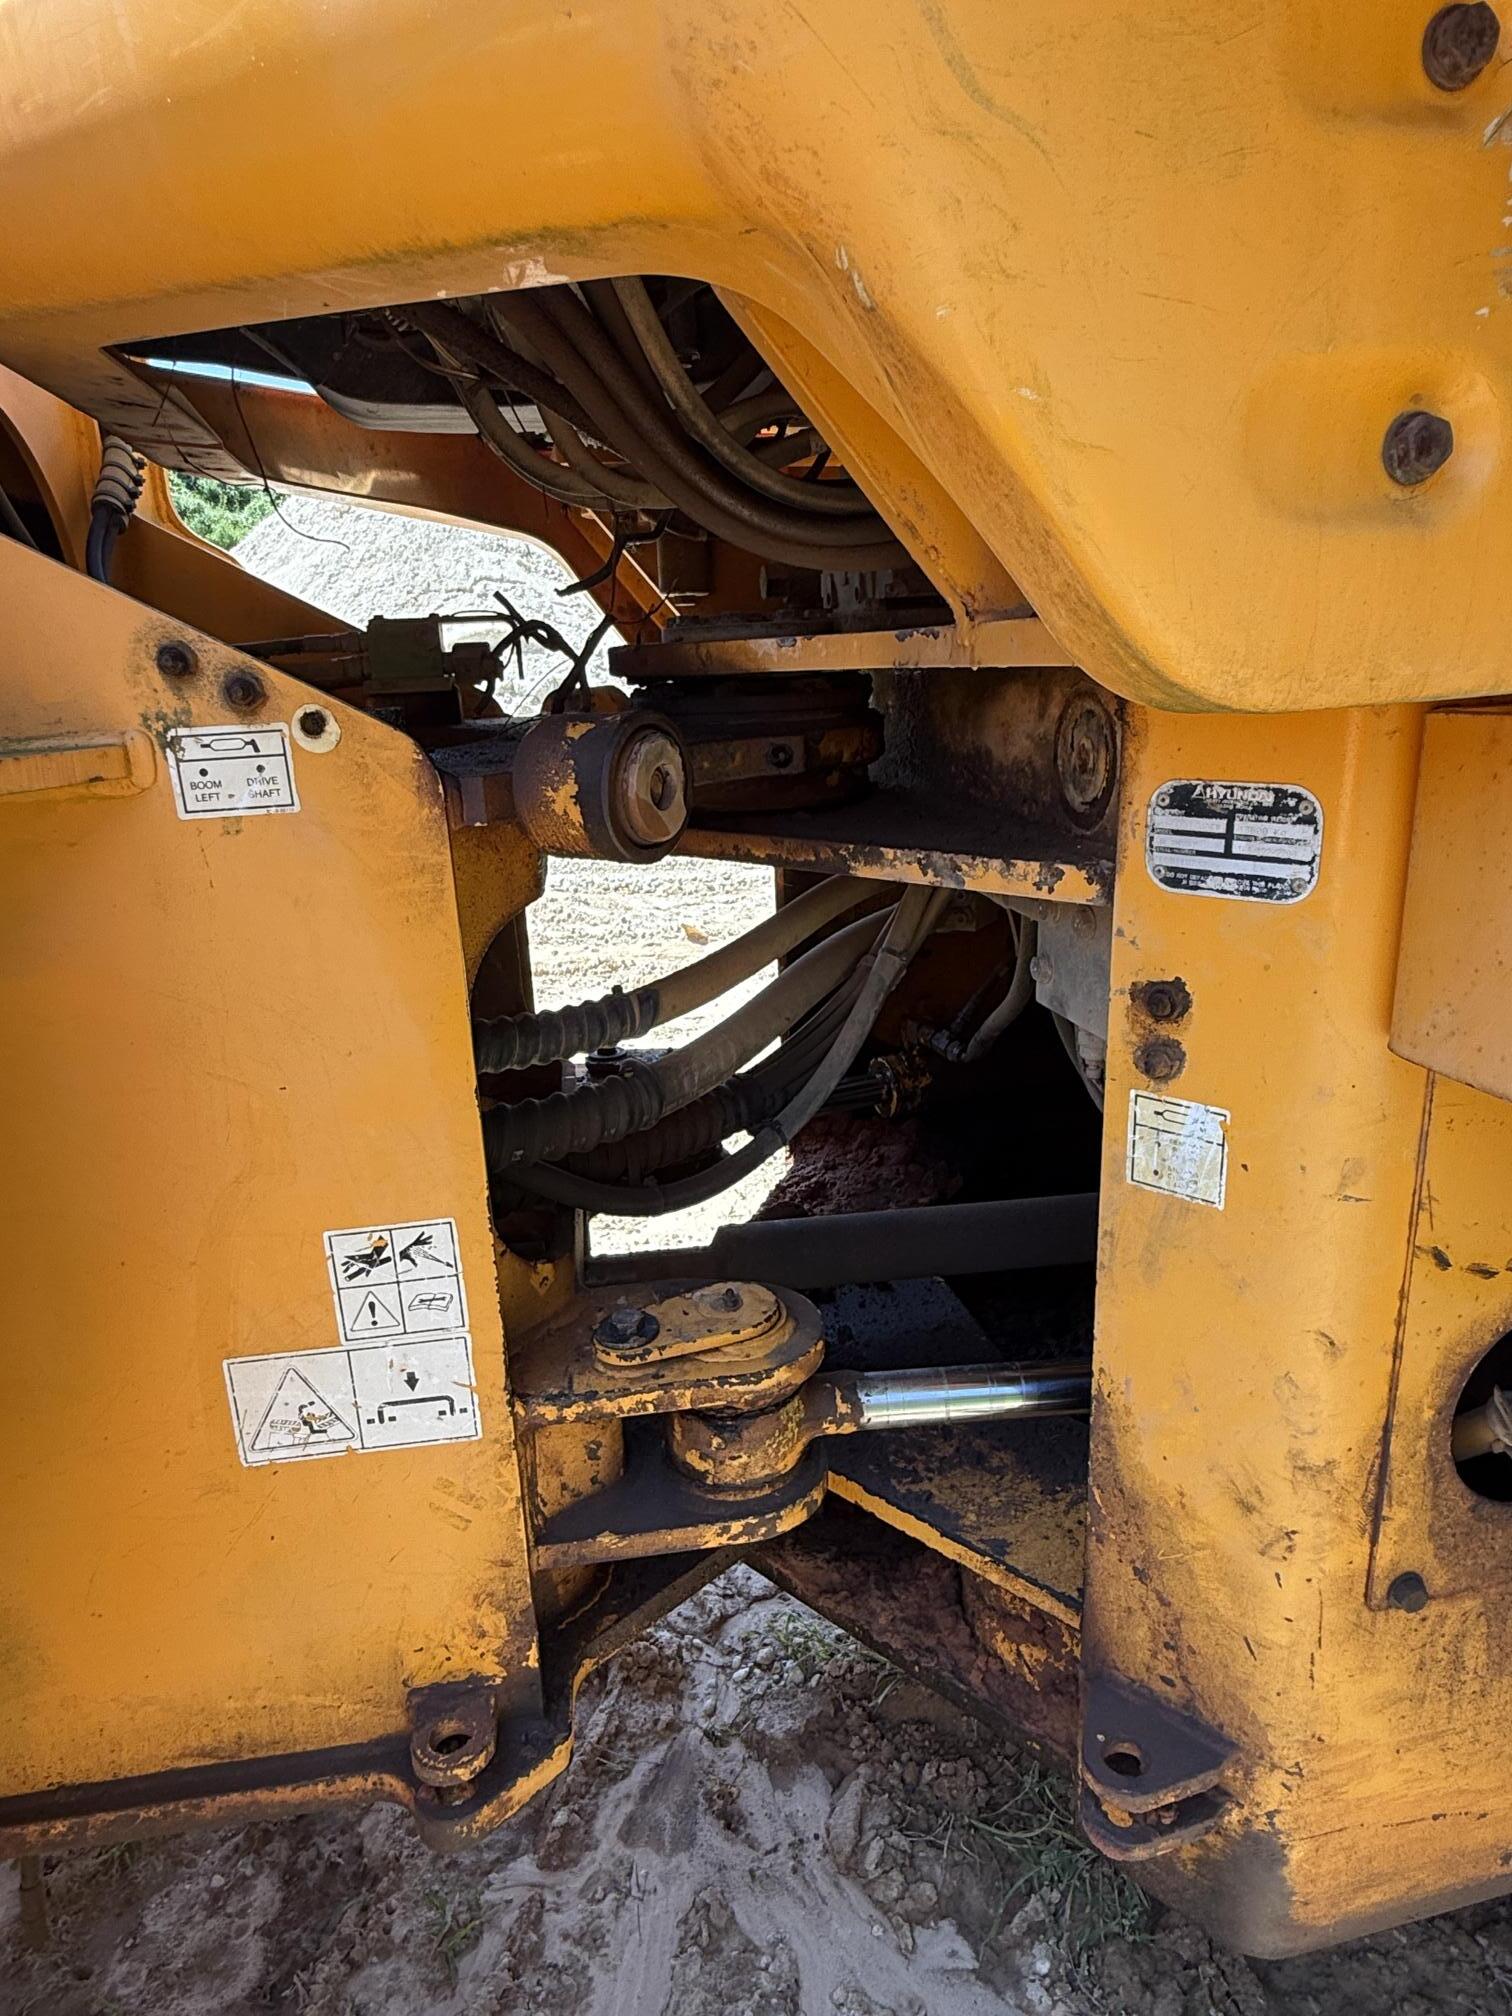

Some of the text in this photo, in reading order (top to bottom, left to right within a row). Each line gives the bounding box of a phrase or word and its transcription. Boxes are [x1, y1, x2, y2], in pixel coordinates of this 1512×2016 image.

[190, 780, 222, 790] BOOM
[246, 776, 279, 787] DRIVE
[195, 793, 220, 802] LEFT
[248, 789, 281, 799] SHAFT
